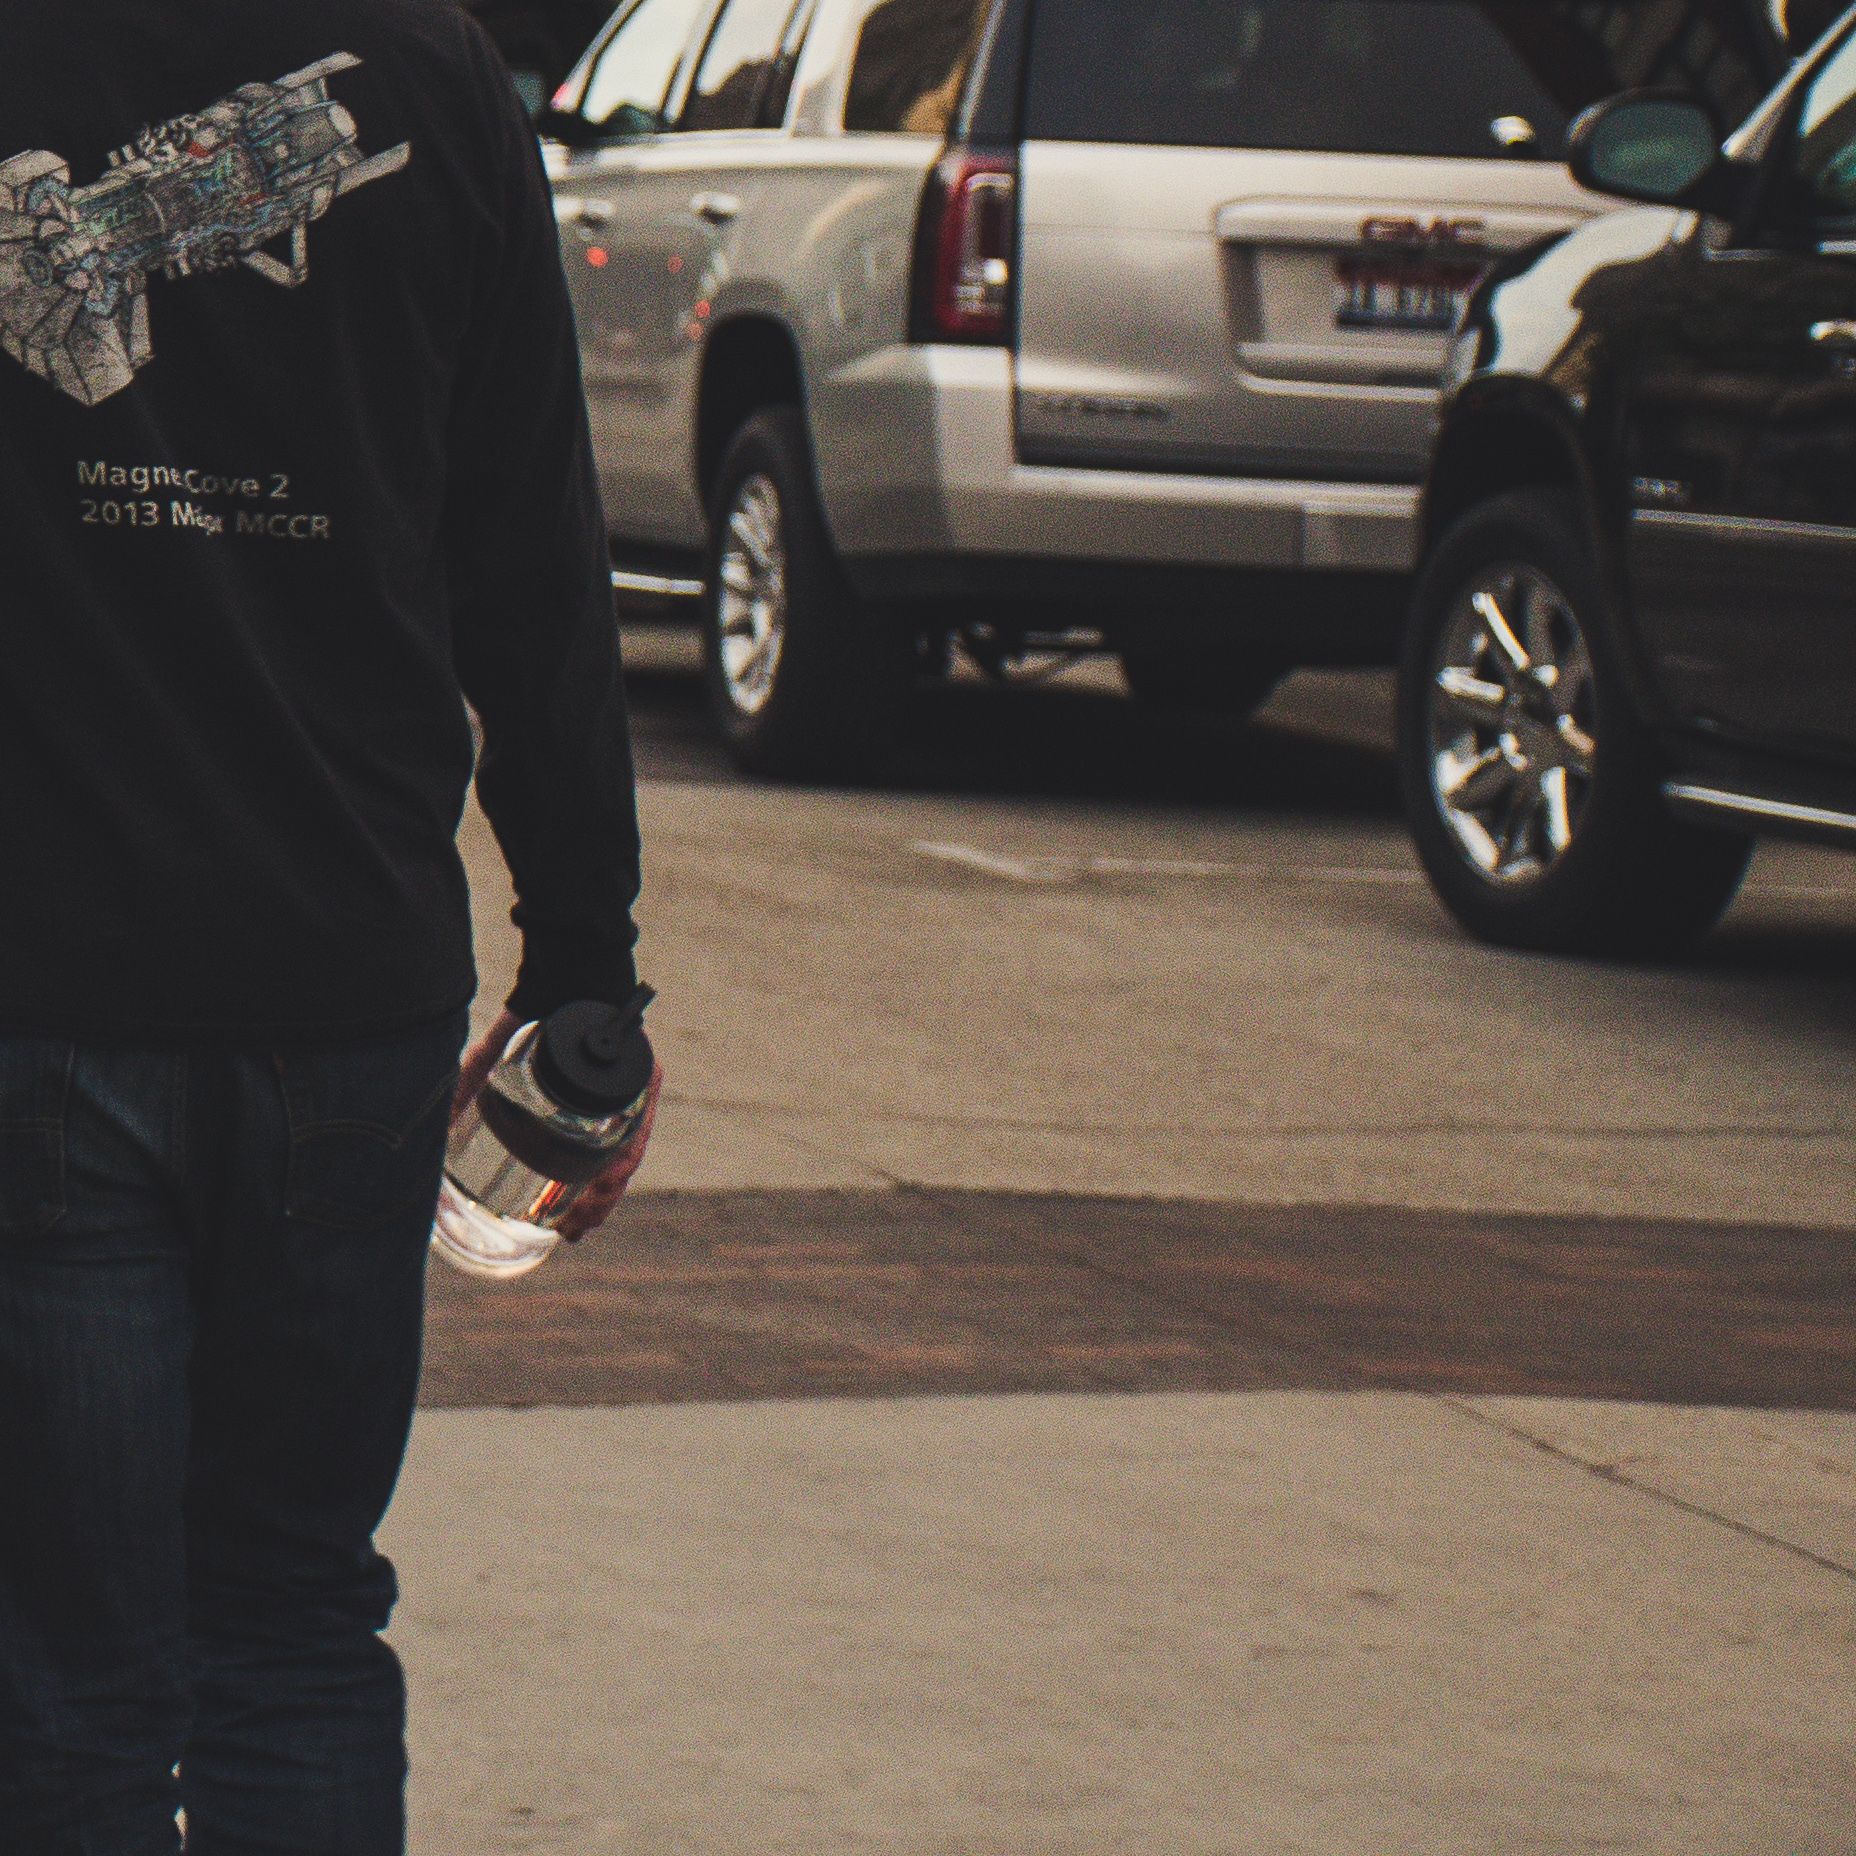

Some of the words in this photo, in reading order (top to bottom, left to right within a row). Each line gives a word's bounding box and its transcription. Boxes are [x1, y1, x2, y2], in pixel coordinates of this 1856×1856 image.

[1359, 214, 1485, 247] GMC
[269, 472, 290, 498] 2
[81, 499, 159, 527] 2013
[236, 510, 331, 540] MCCR
